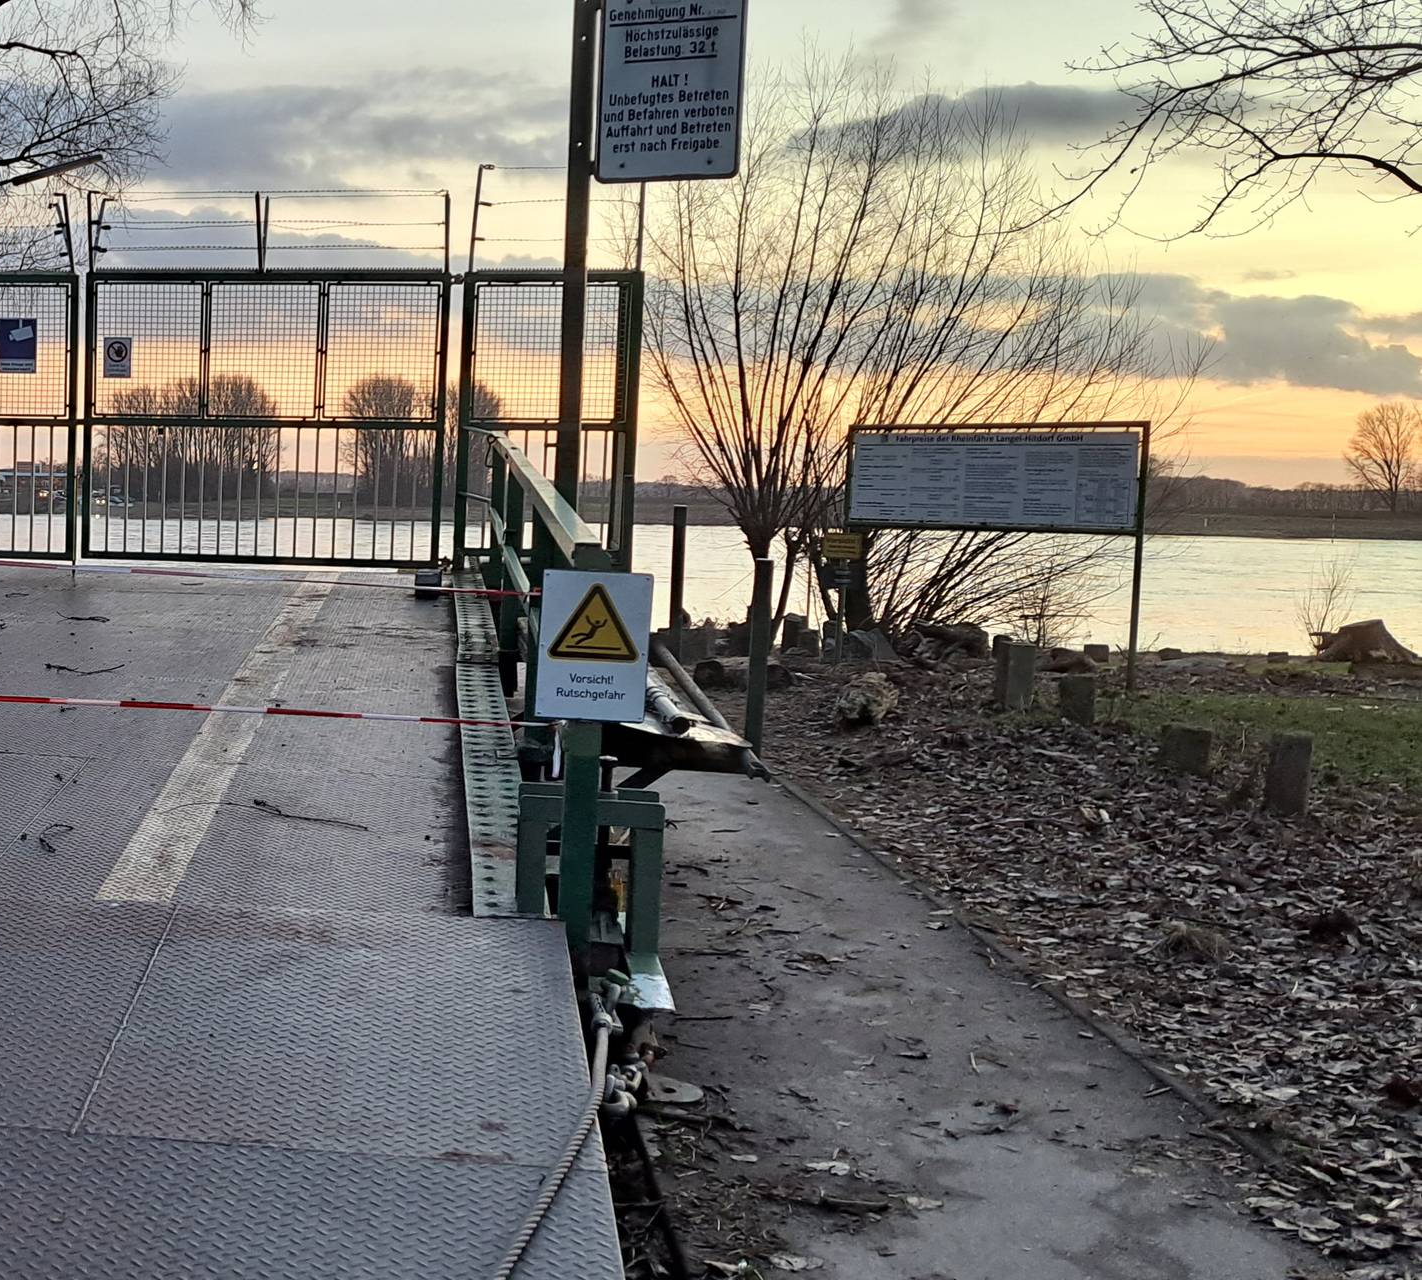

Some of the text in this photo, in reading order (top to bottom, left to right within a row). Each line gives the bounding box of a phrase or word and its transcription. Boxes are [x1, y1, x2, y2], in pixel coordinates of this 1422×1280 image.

[610, 5, 685, 22] Genehmigung
[689, 4, 705, 16] Nr.
[625, 25, 719, 42] Höchstzulässige
[689, 42, 706, 54] 32
[651, 73, 689, 88] HALT !
[609, 89, 729, 107] Unbefugtes Betreten
[603, 104, 735, 123] und Befahren verboten
[606, 121, 731, 138] Auffahrt und Betreten
[612, 140, 636, 154] erst
[640, 139, 667, 152] nach
[936, 434, 949, 443] der
[1056, 434, 1084, 443] GmbH
[569, 673, 614, 685] Vorsicht!
[556, 687, 626, 701] Rutschgefahr
